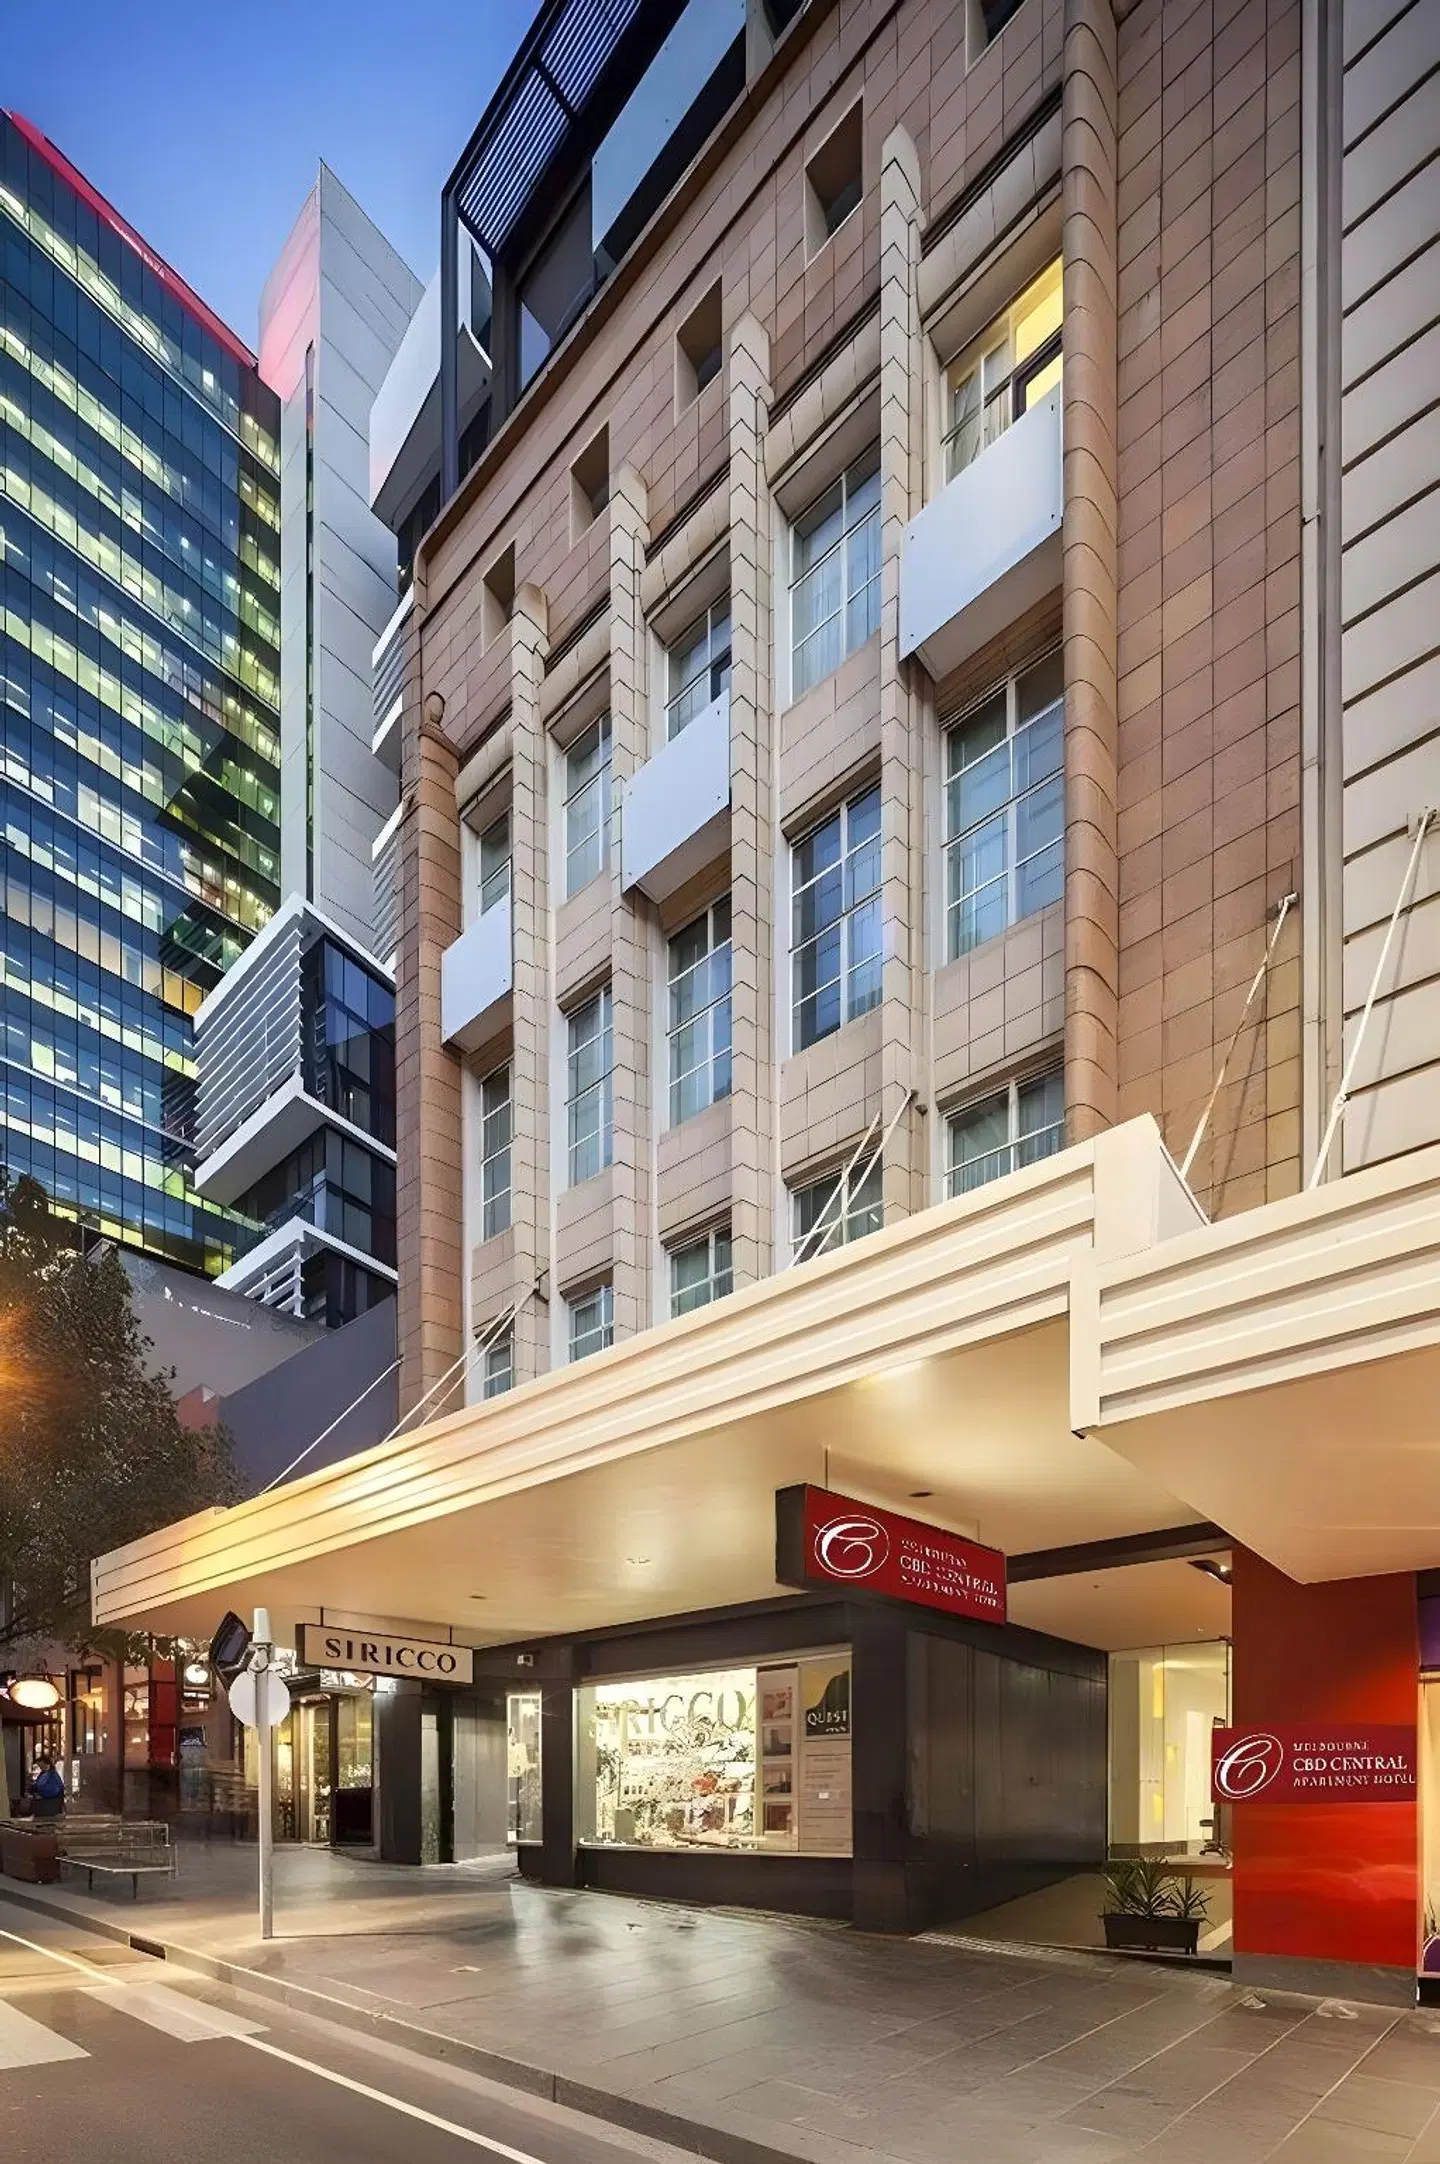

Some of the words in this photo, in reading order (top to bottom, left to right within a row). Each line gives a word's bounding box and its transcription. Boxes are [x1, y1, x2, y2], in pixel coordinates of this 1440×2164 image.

[325, 1638, 457, 1673] SIRICCO
[1293, 1758, 1327, 1771] CBD
[1330, 1755, 1408, 1771] CENTRAL
